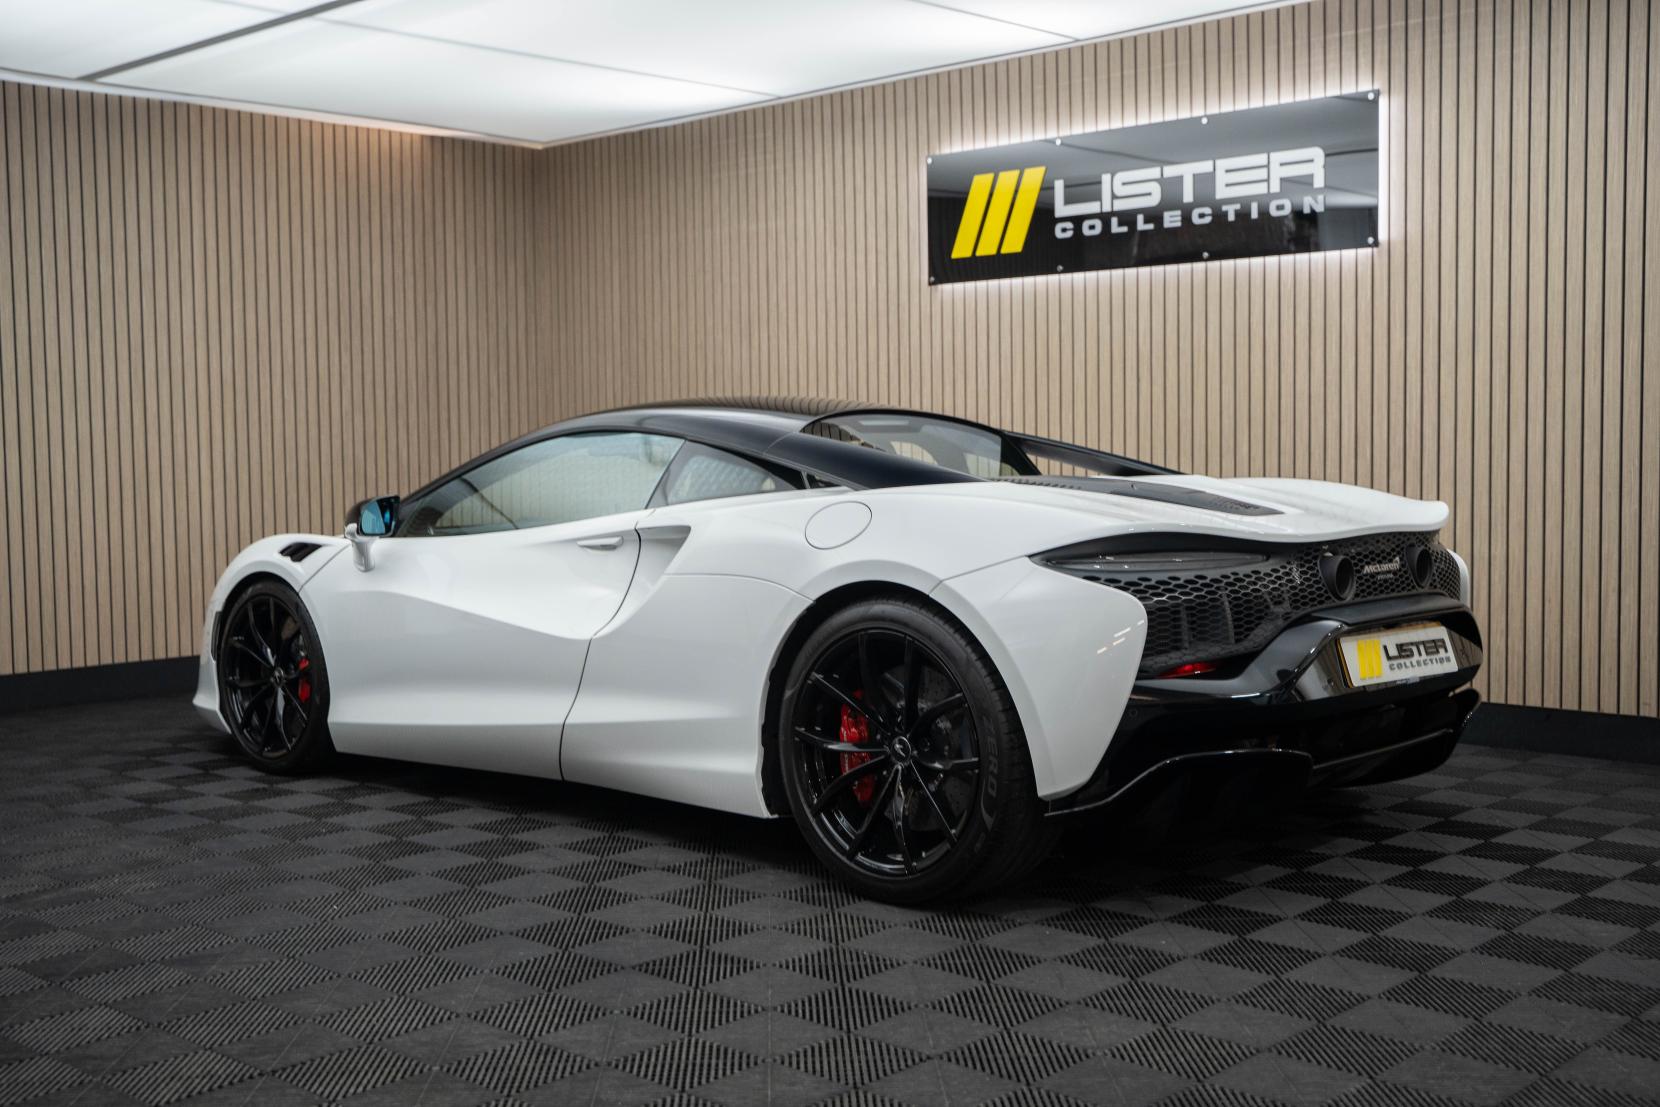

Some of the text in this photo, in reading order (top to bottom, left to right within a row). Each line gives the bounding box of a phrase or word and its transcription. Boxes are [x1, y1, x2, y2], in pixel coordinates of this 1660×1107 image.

[1054, 146, 1326, 219] LISTER
[1054, 194, 1326, 239] COLLECTION
[1363, 560, 1399, 574] McLaren
[1383, 638, 1448, 661] LISTER
[1389, 657, 1451, 671] COLLECTION
